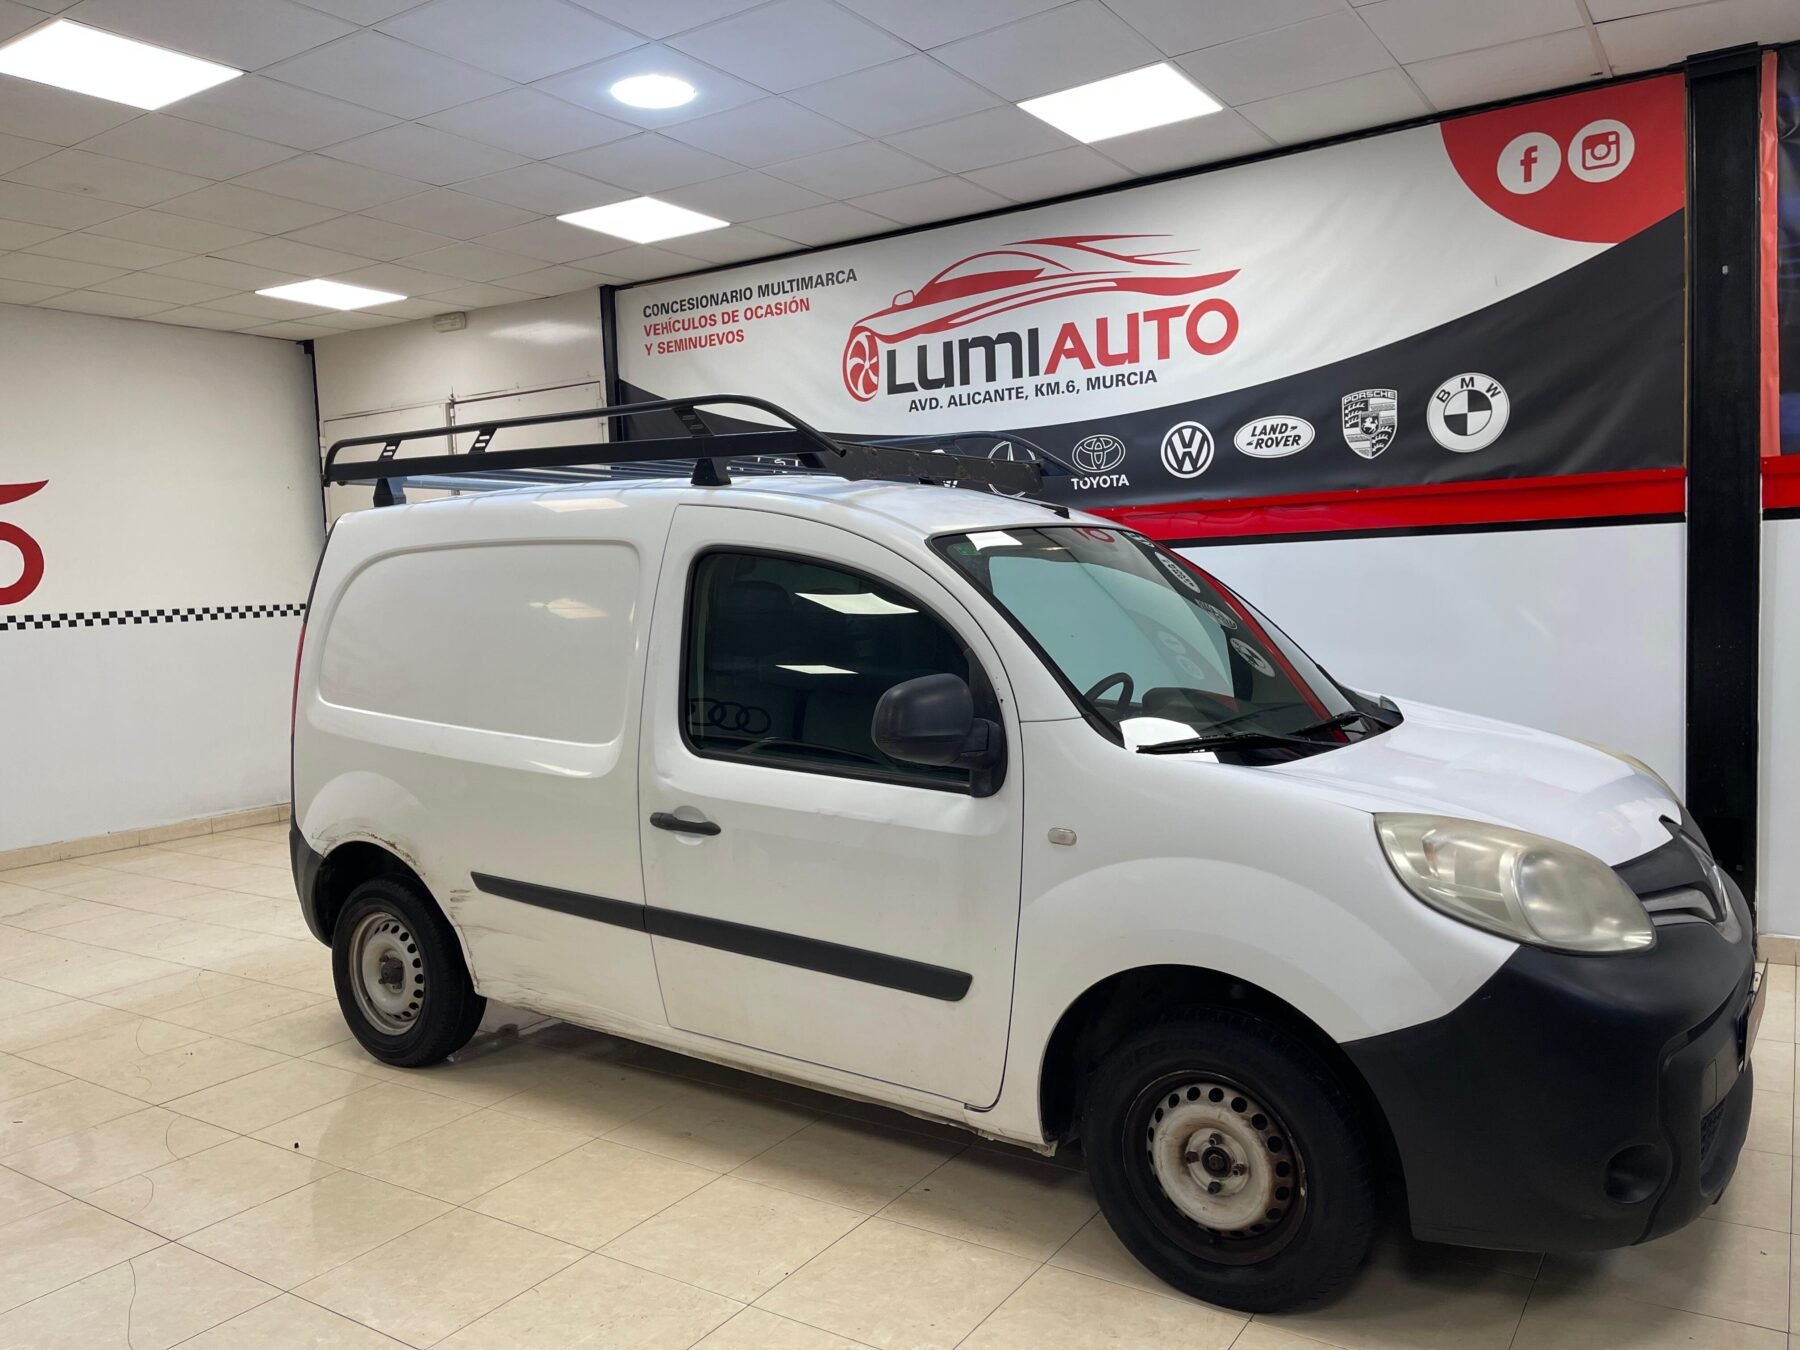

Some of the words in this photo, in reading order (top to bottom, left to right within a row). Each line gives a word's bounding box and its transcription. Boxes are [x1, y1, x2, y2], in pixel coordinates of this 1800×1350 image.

[643, 287, 753, 318] CONCESIONARIO
[758, 269, 858, 298] MULTIMARCA
[644, 313, 717, 337] VEHÍCULOS
[721, 310, 739, 324] DE
[743, 296, 811, 320] OCASIÓN
[644, 343, 653, 356] Y
[657, 329, 744, 354] SEMINUEVOS
[908, 397, 944, 412] AVD.
[947, 386, 1029, 408] ALICANTE,
[1034, 379, 1081, 398] KM.6,
[1086, 369, 1158, 391] MURCIA
[1343, 389, 1396, 405] PORSCHE
[1250, 422, 1289, 437] LAND
[1254, 434, 1302, 449] ROVER
[1070, 474, 1130, 490] TOYOTA
